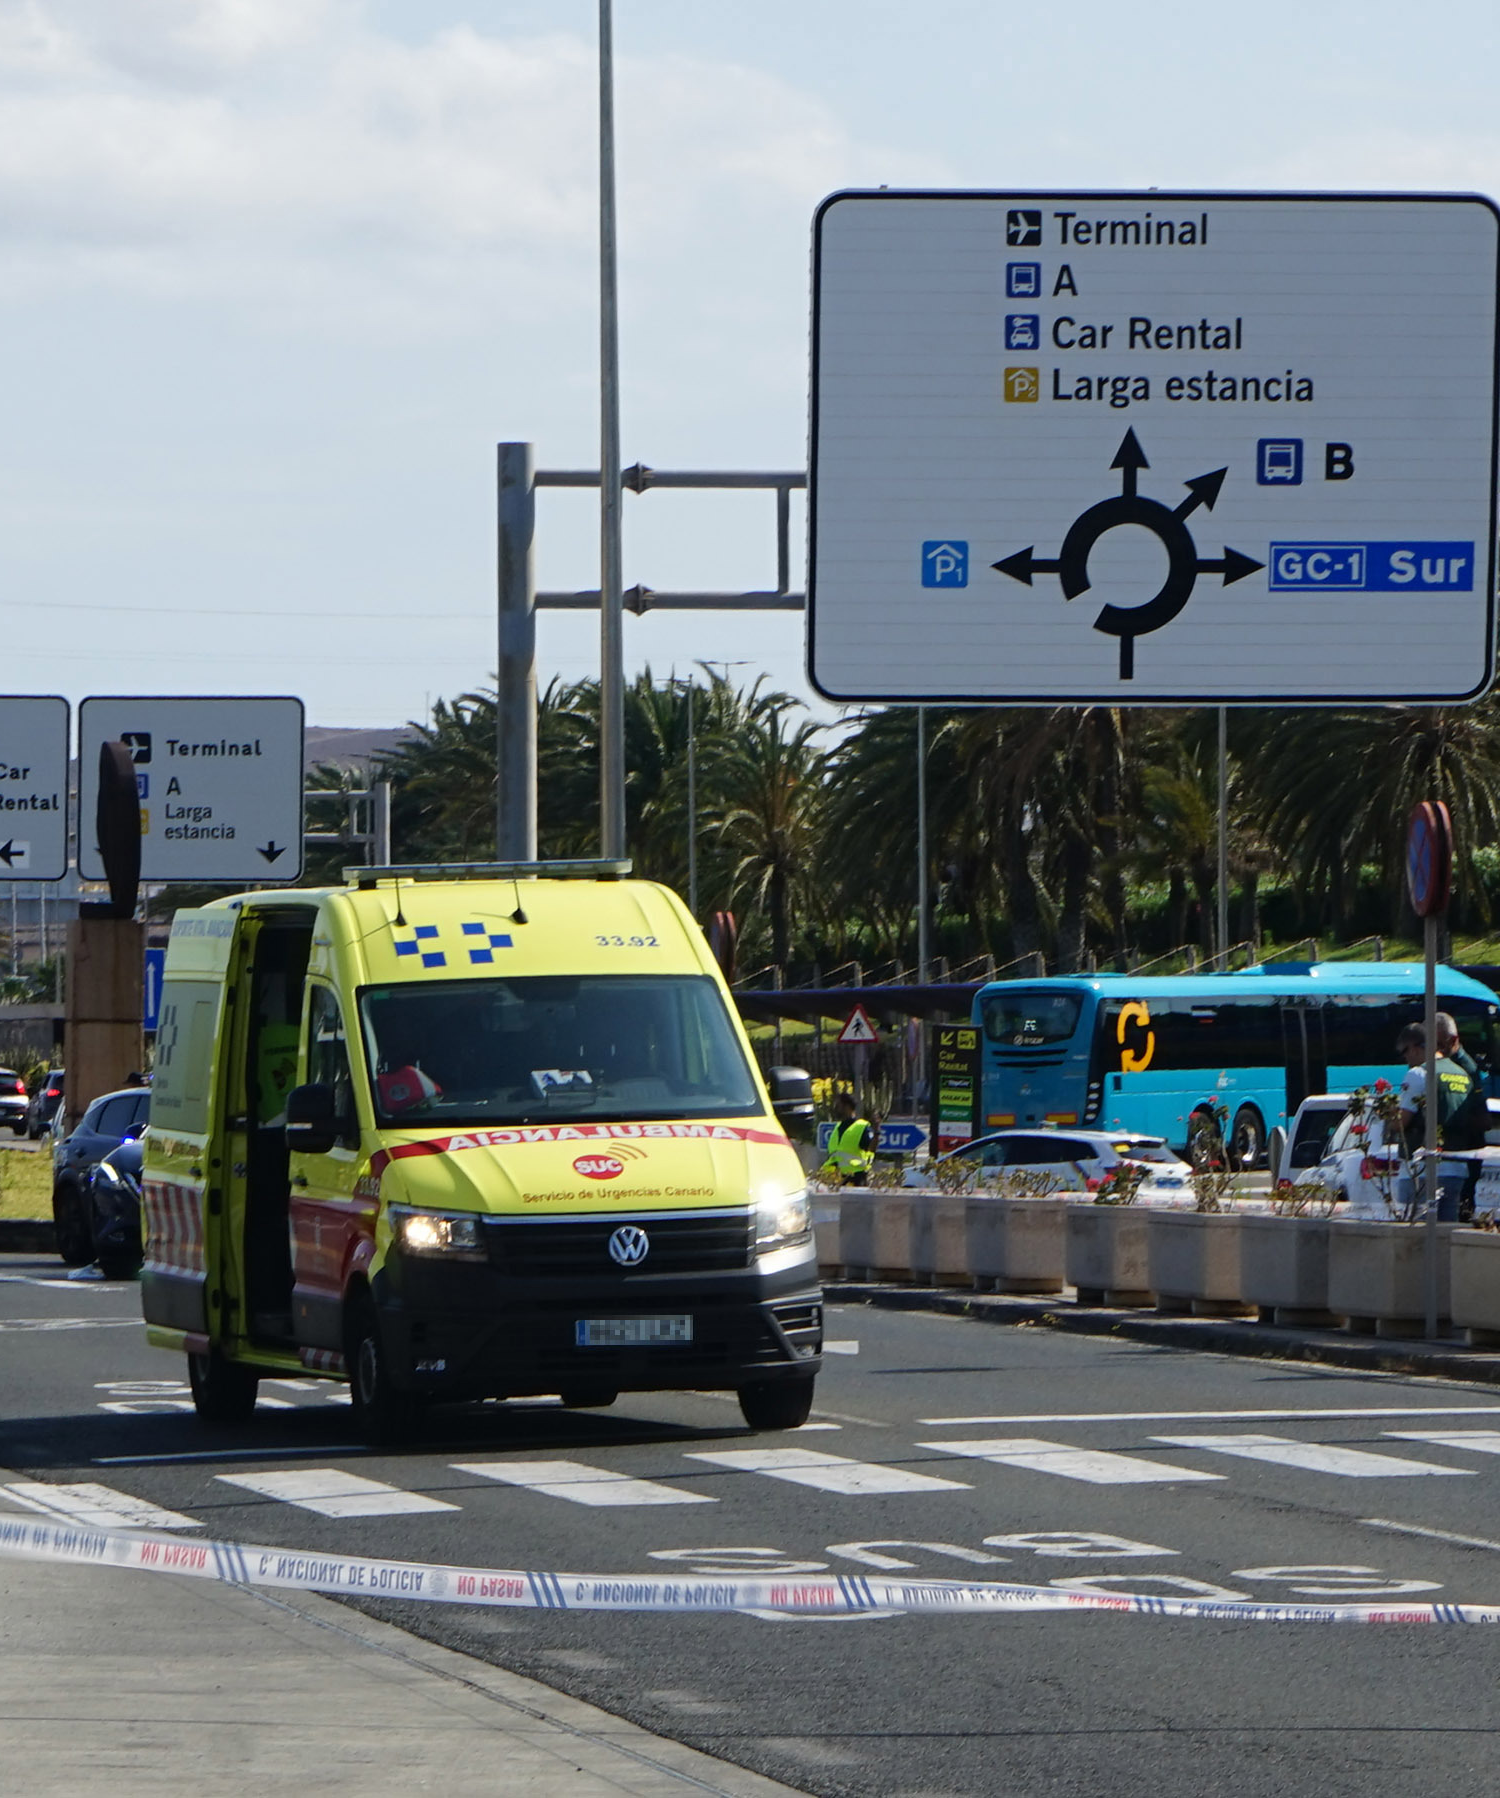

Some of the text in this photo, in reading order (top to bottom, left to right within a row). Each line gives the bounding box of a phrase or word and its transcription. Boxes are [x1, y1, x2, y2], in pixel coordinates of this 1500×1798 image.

[1053, 211, 1209, 247] Terminal
[1051, 263, 1079, 297] A
[1051, 315, 1243, 350] Car Rental
[1052, 368, 1151, 408] Larga
[1165, 369, 1315, 402] estancia
[1323, 442, 1355, 482] B
[1276, 549, 1467, 585] GC-1 Sur
[166, 739, 263, 757] Terminal
[166, 776, 182, 797] A
[165, 803, 213, 824] Larga
[164, 824, 236, 840] estancia
[595, 935, 660, 948] 33.92
[938, 1050, 956, 1061] Car
[574, 1159, 623, 1174] SUC
[522, 1185, 715, 1204] Servicio de Urgencias Canario
